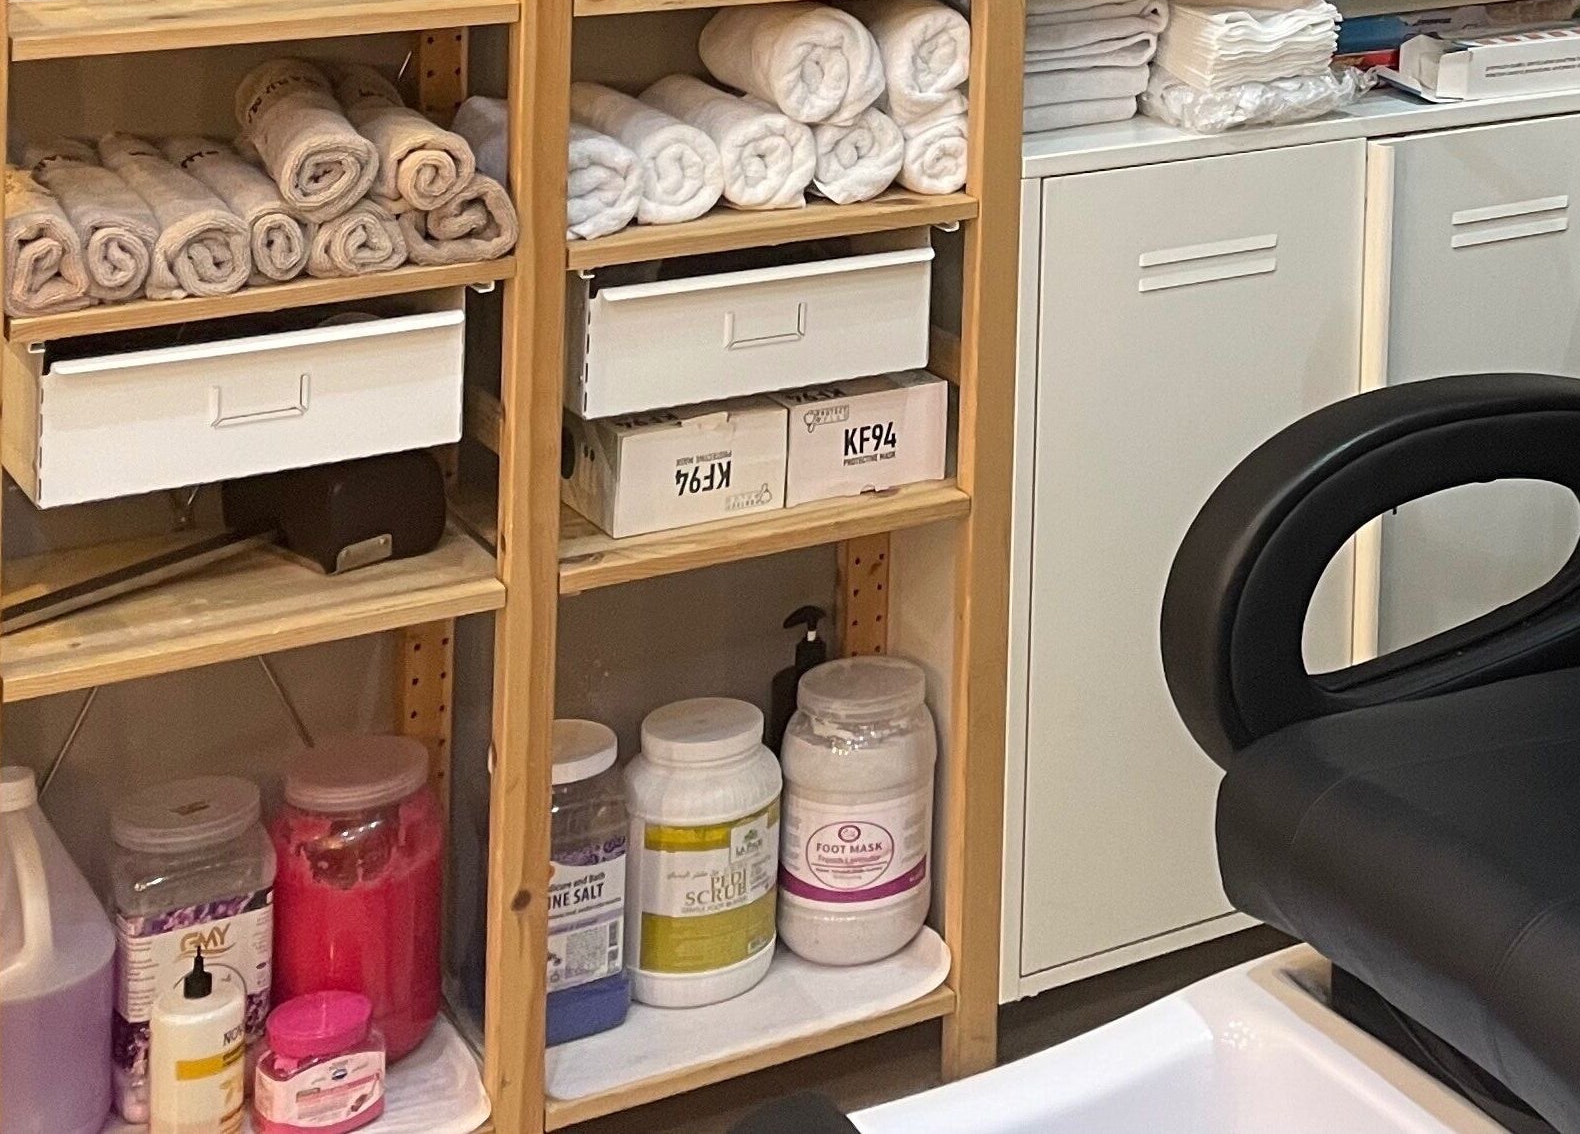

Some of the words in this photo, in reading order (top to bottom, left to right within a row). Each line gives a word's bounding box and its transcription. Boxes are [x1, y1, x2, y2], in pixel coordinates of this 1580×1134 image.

[844, 421, 896, 456] KF94
[675, 460, 732, 496] KF94
[817, 843, 846, 854] FOOT
[850, 842, 883, 854] MASK
[711, 868, 747, 887] PEDI
[574, 883, 604, 905] SALT
[685, 882, 747, 905] SCRUB
[180, 923, 231, 953] GMY
